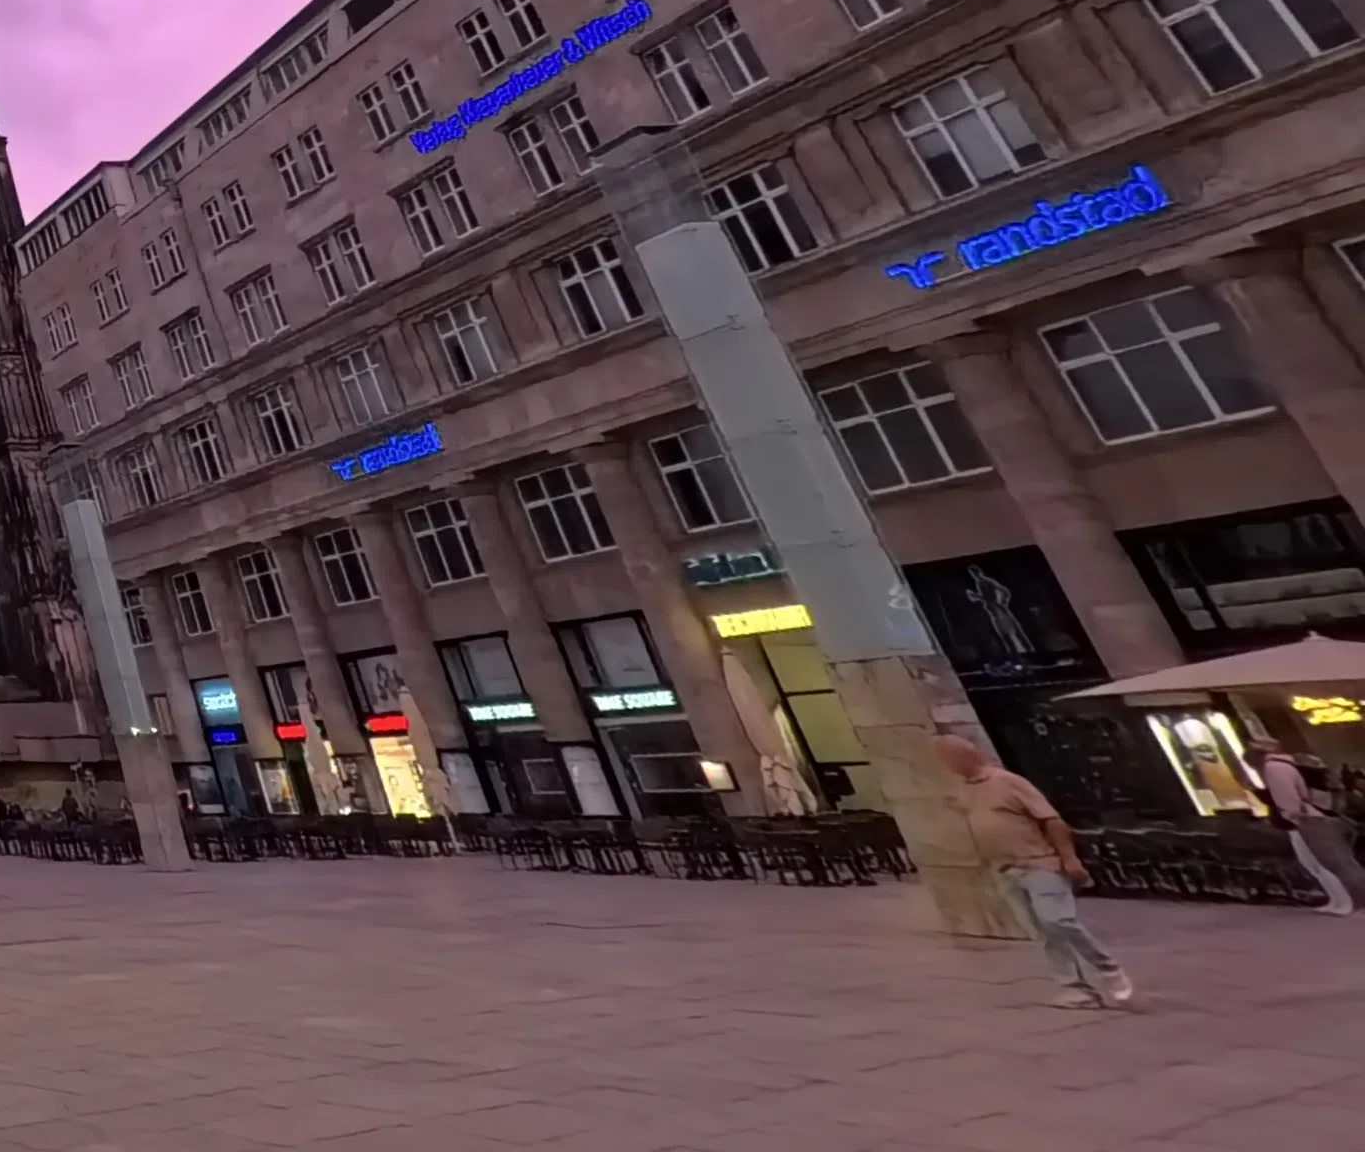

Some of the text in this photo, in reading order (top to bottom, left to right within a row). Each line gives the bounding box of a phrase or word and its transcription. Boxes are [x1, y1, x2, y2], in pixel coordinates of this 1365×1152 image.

[409, 113, 467, 154] Verlag
[561, 37, 585, 64] &
[957, 162, 1173, 271] randstad
[358, 419, 442, 475] randstad
